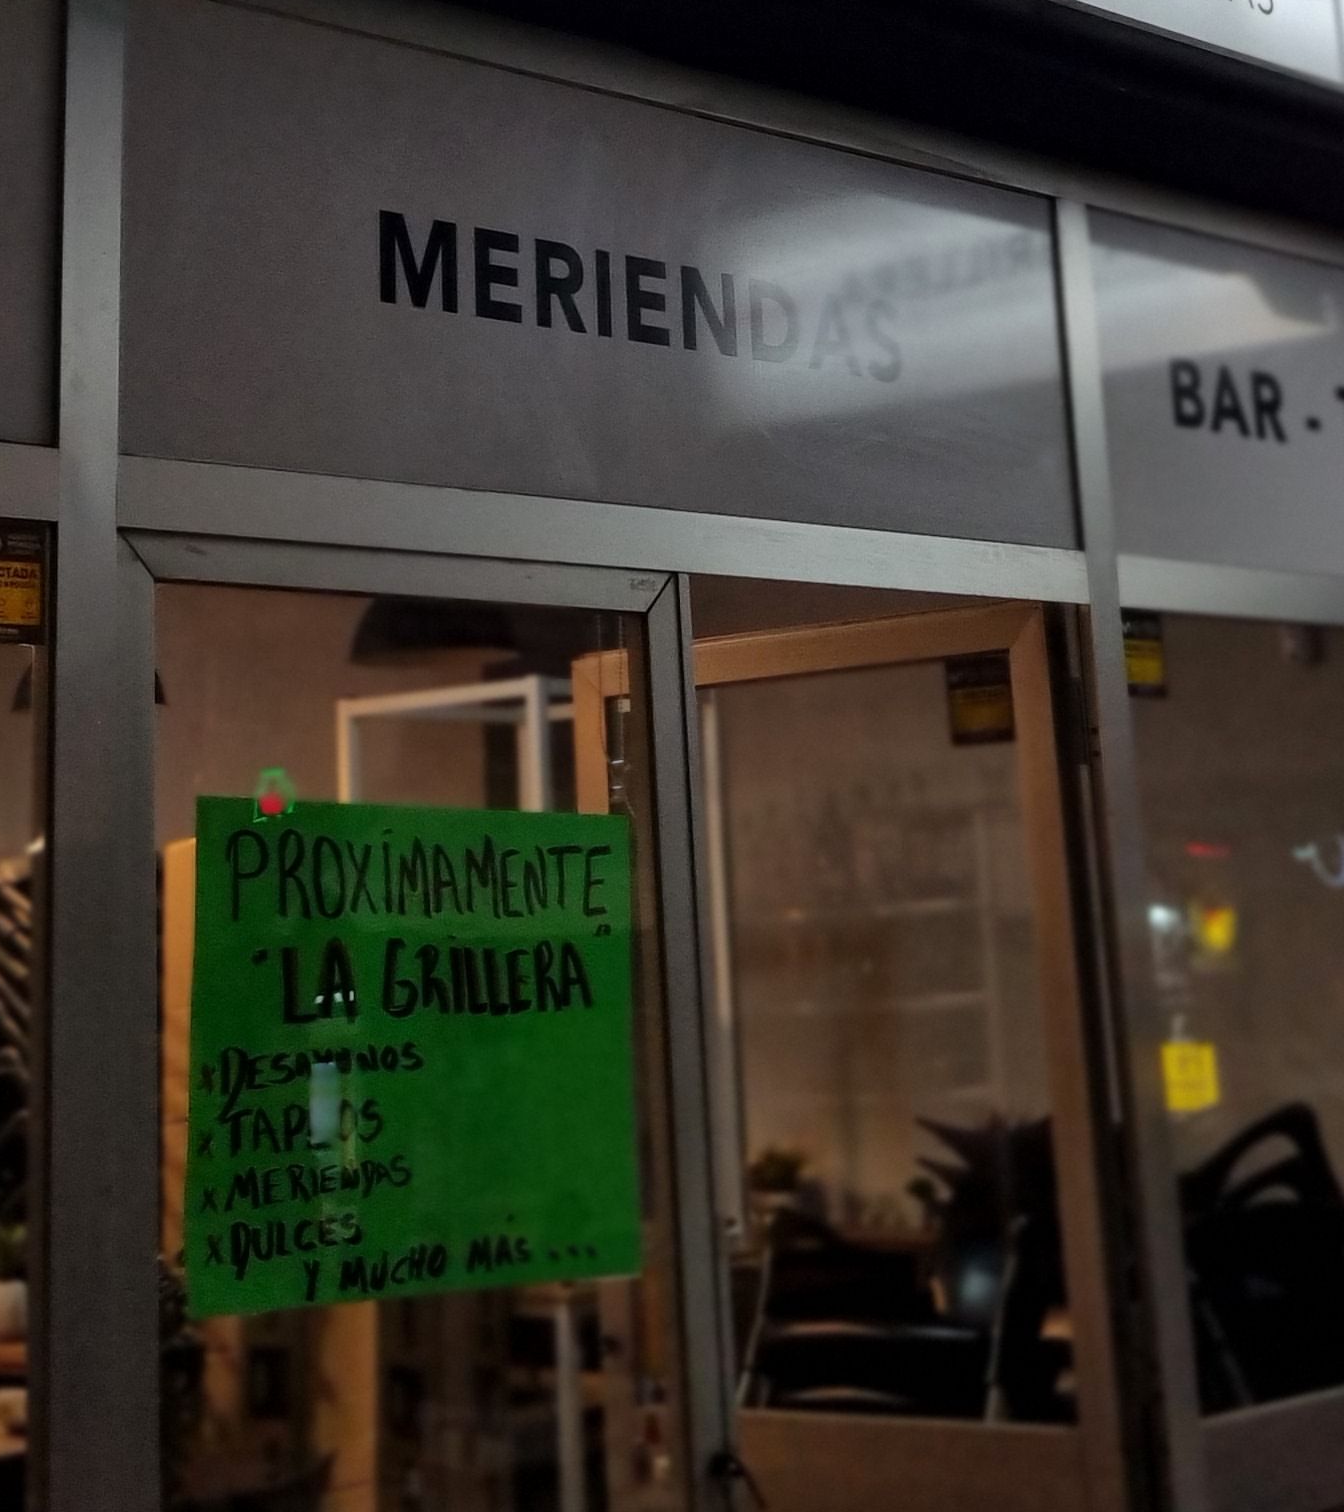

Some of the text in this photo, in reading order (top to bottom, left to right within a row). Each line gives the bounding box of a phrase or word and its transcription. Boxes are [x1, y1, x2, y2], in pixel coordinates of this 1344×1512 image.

[377, 208, 904, 384] MERIENDAS
[1167, 358, 1289, 445] BAR
[224, 1153, 414, 1213] MERIENDAS
[230, 1212, 365, 1281] DULCES
[337, 1242, 449, 1294] MUCHO
